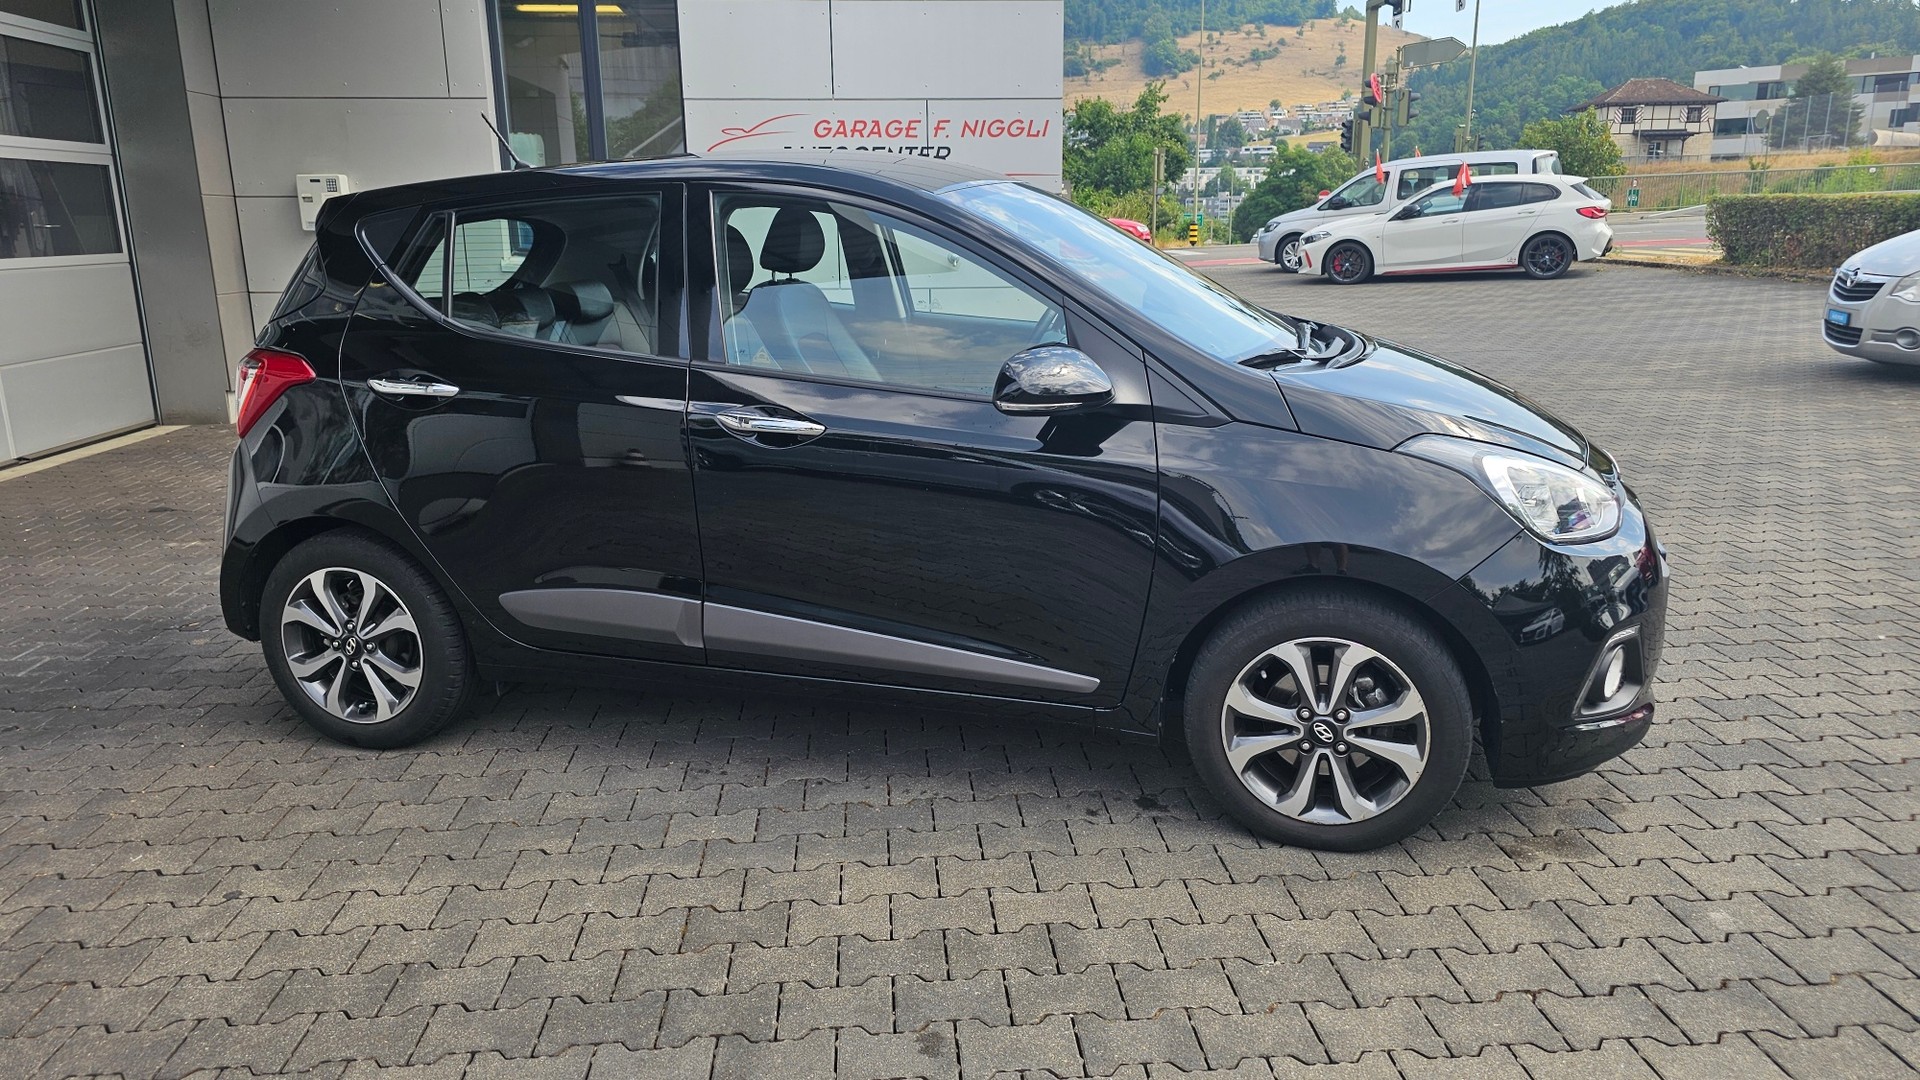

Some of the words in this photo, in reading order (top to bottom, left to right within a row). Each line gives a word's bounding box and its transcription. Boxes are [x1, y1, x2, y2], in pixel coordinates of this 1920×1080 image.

[814, 119, 922, 138] GARAGE
[933, 119, 951, 138] F.
[960, 119, 1050, 138] NIGGLI
